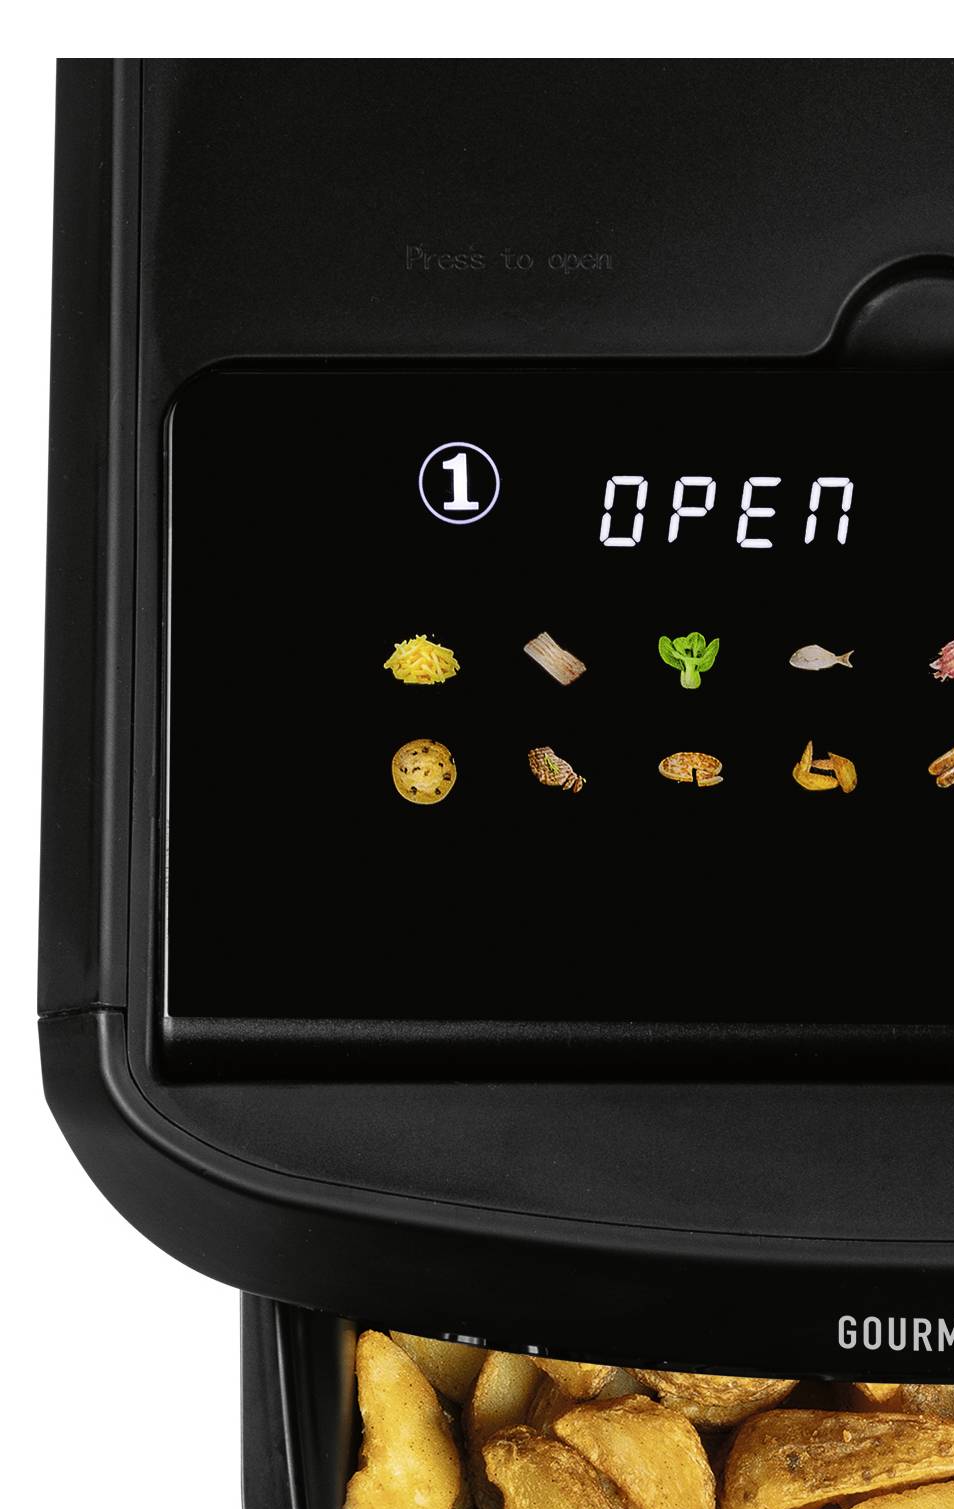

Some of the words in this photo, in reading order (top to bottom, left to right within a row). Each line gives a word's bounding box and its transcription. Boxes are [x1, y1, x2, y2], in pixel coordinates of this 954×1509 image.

[404, 243, 487, 271] Press
[500, 246, 535, 271] to
[546, 250, 613, 275] open
[441, 452, 480, 511] 1
[599, 475, 855, 549] OPEN
